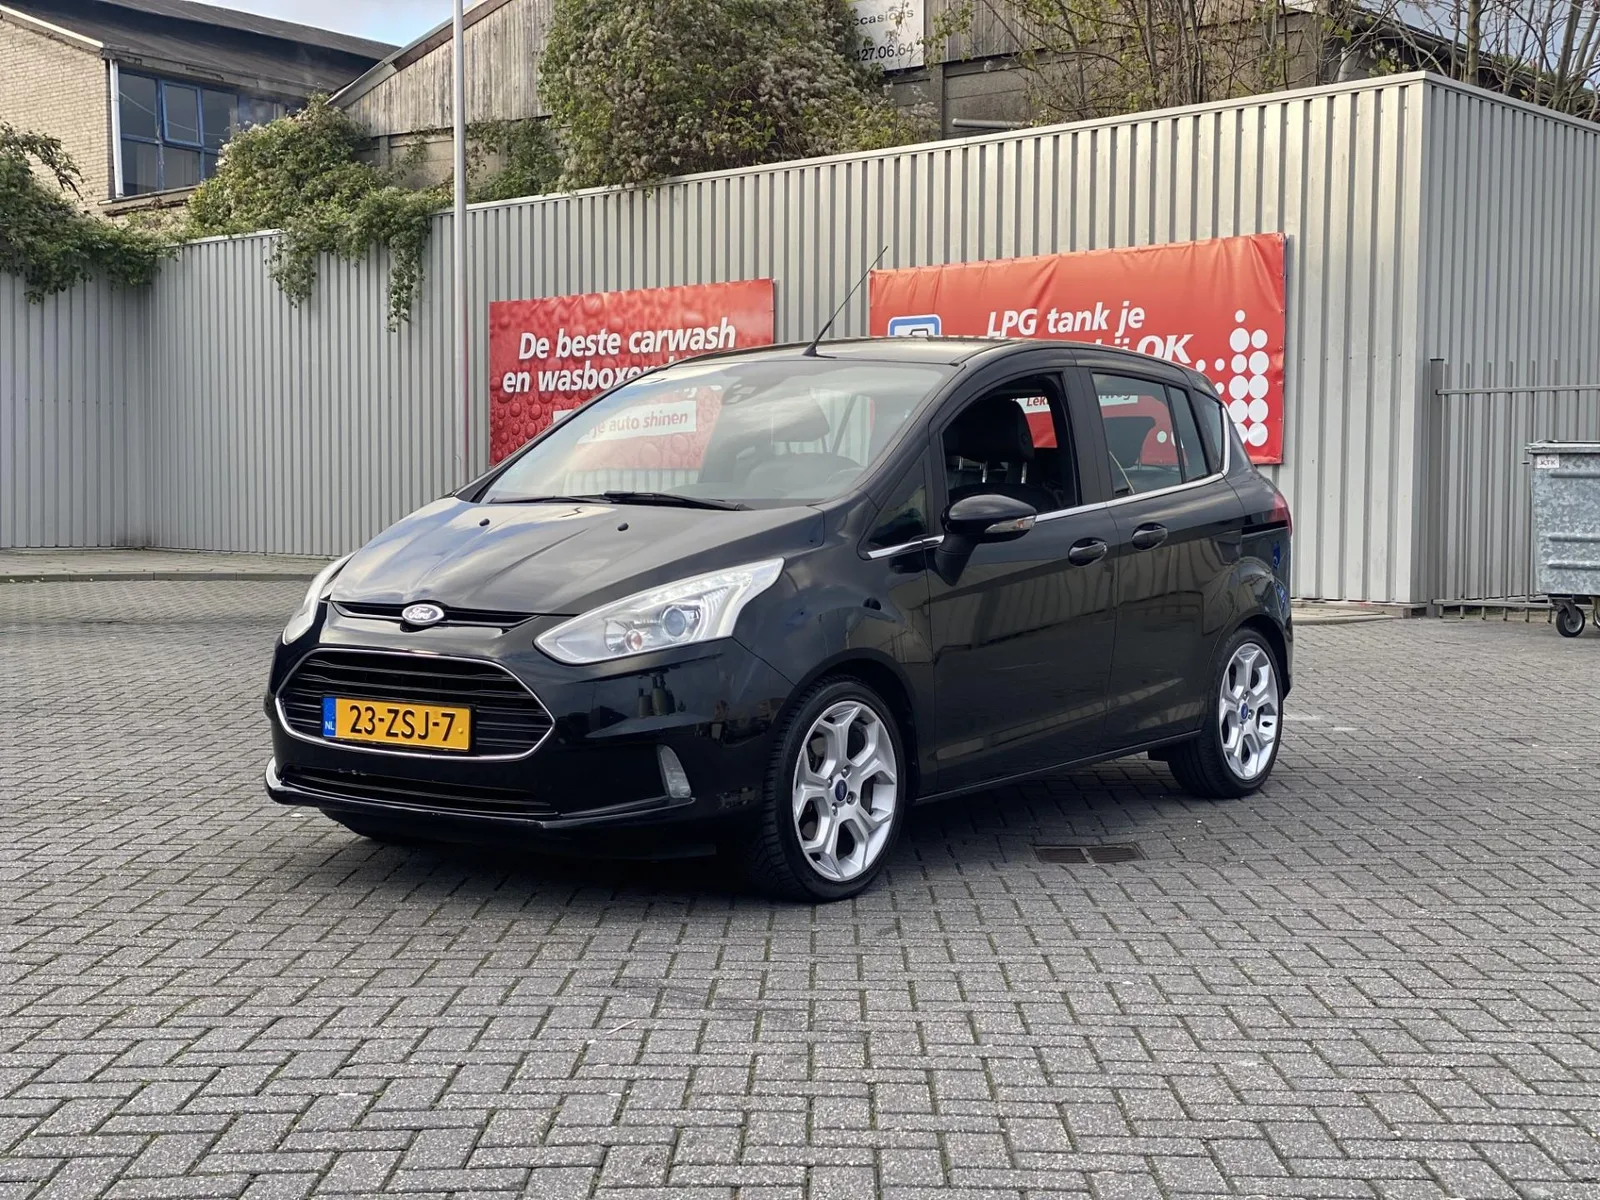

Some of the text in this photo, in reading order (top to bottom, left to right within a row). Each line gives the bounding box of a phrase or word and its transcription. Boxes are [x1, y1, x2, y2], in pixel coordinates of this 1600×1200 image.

[852, 9, 914, 27] ccasions
[987, 300, 1146, 338] LPG tank je
[518, 316, 737, 360] De beste carwash
[1136, 333, 1194, 364] OK
[502, 369, 531, 393] en
[538, 360, 657, 393] wasboxe
[608, 416, 640, 432] auto
[642, 410, 688, 429] shinen
[324, 720, 335, 731] NL
[349, 704, 456, 742] 23-ZSJ-7
